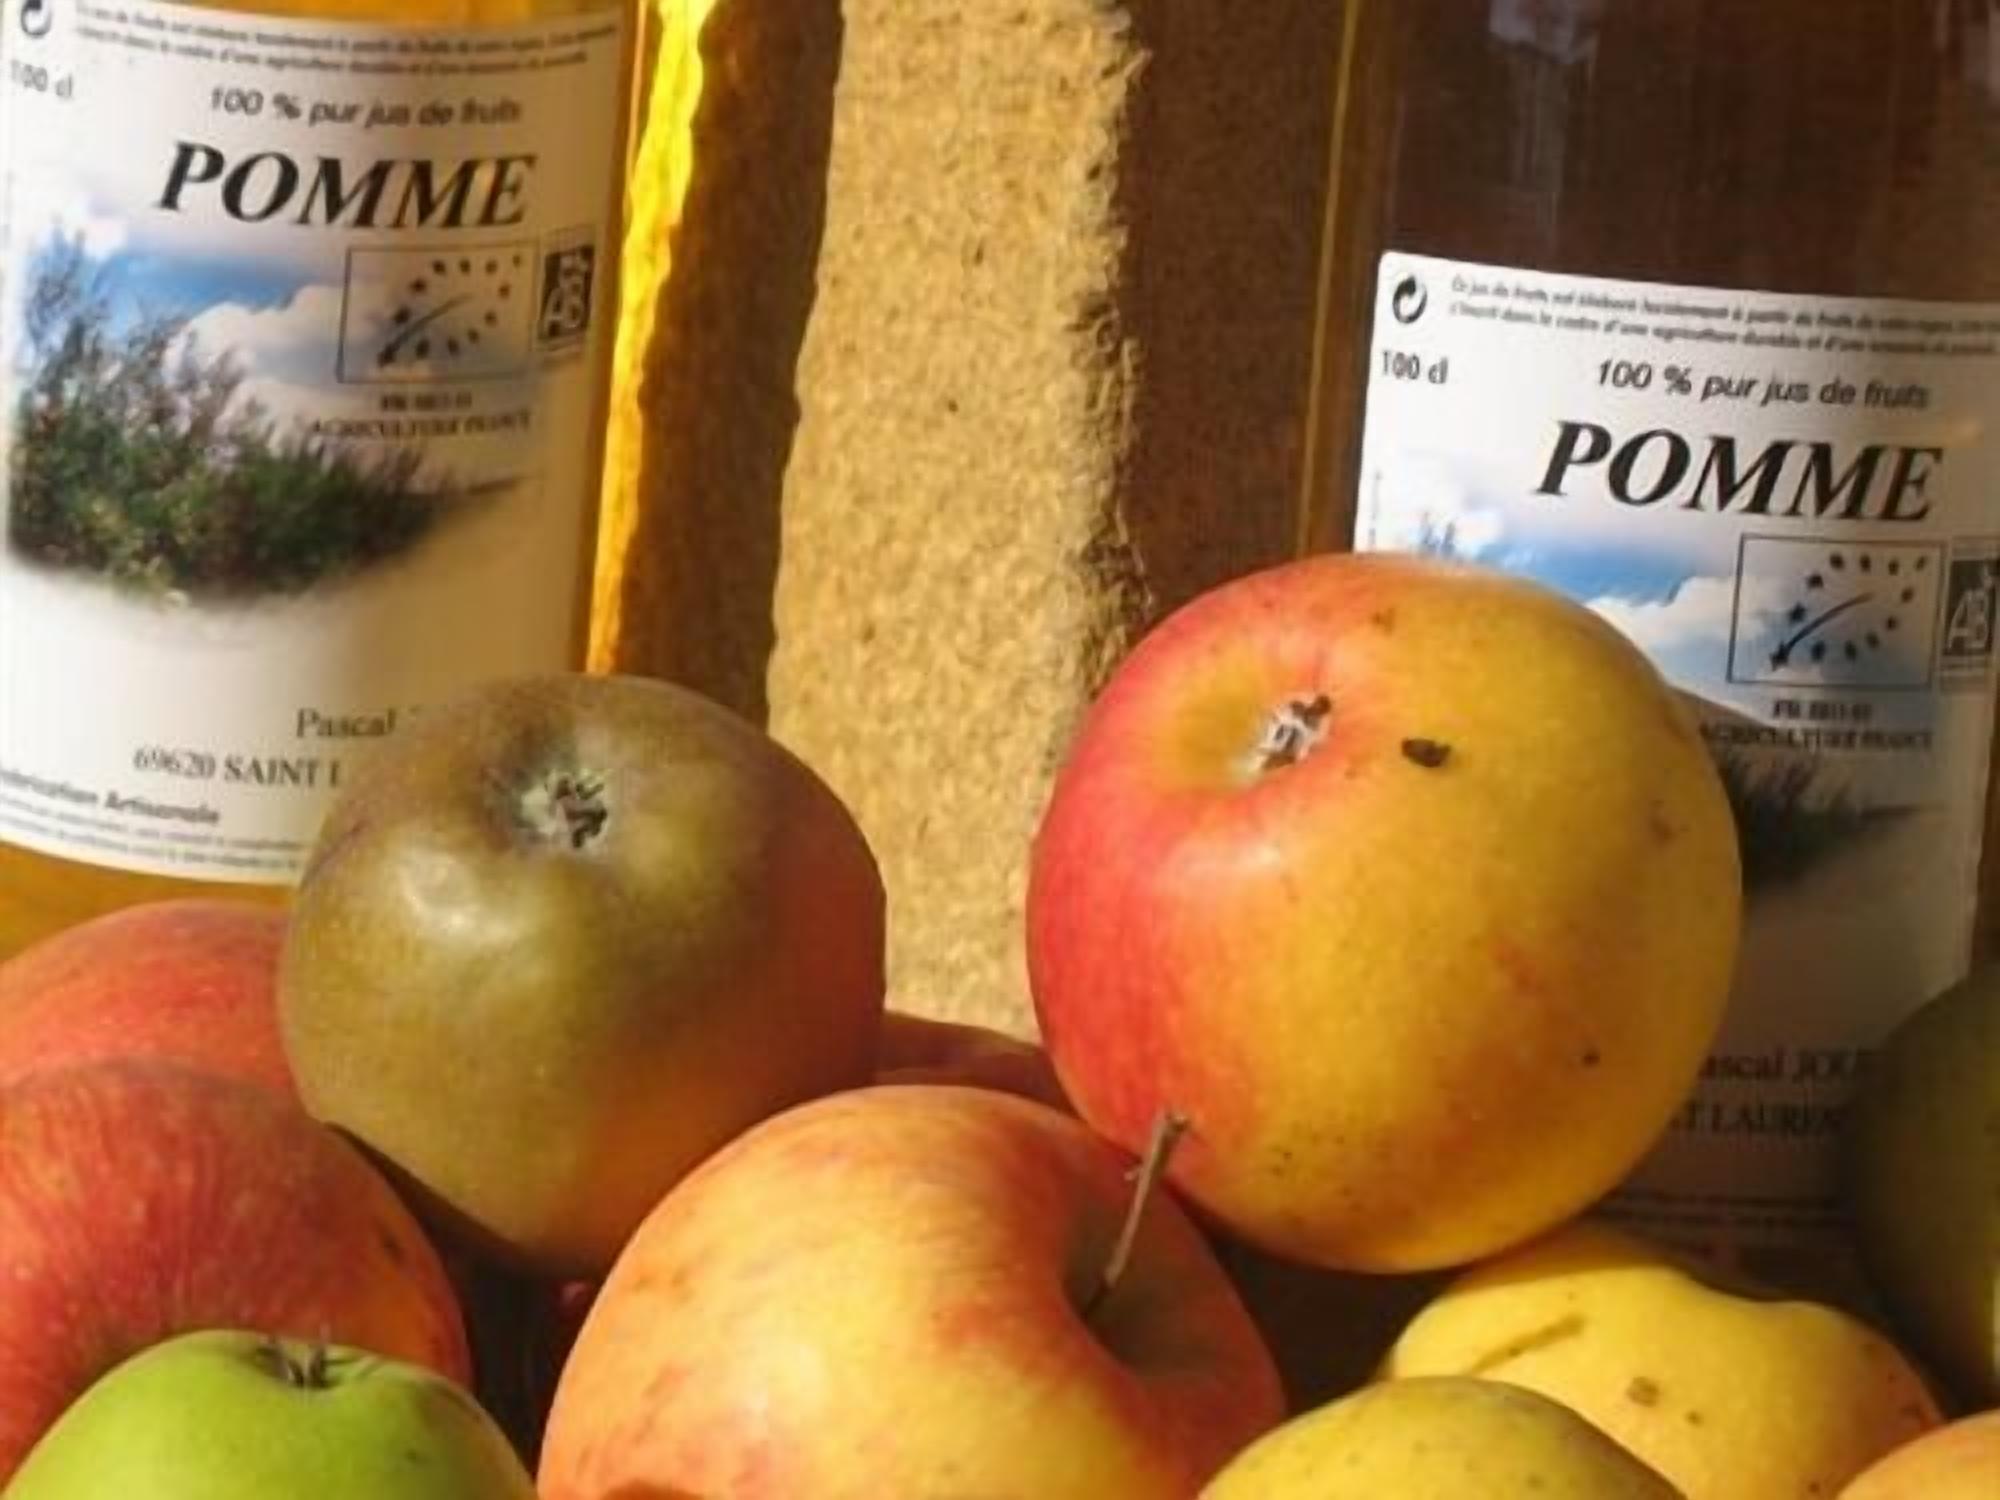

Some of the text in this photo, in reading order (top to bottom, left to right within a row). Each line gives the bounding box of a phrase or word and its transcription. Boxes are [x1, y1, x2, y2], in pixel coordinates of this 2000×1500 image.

[10, 59, 73, 98] 100 cl
[211, 86, 521, 129] 100 % pur jus de fruits
[155, 140, 538, 230] POMME
[1380, 351, 1448, 385] 100 cl
[1599, 358, 1930, 410] 100 % pur jus de fruits
[1532, 418, 1945, 522] POMME
[296, 707, 397, 739] Pascal
[133, 746, 217, 780] 69620
[223, 753, 319, 789] SAINT
